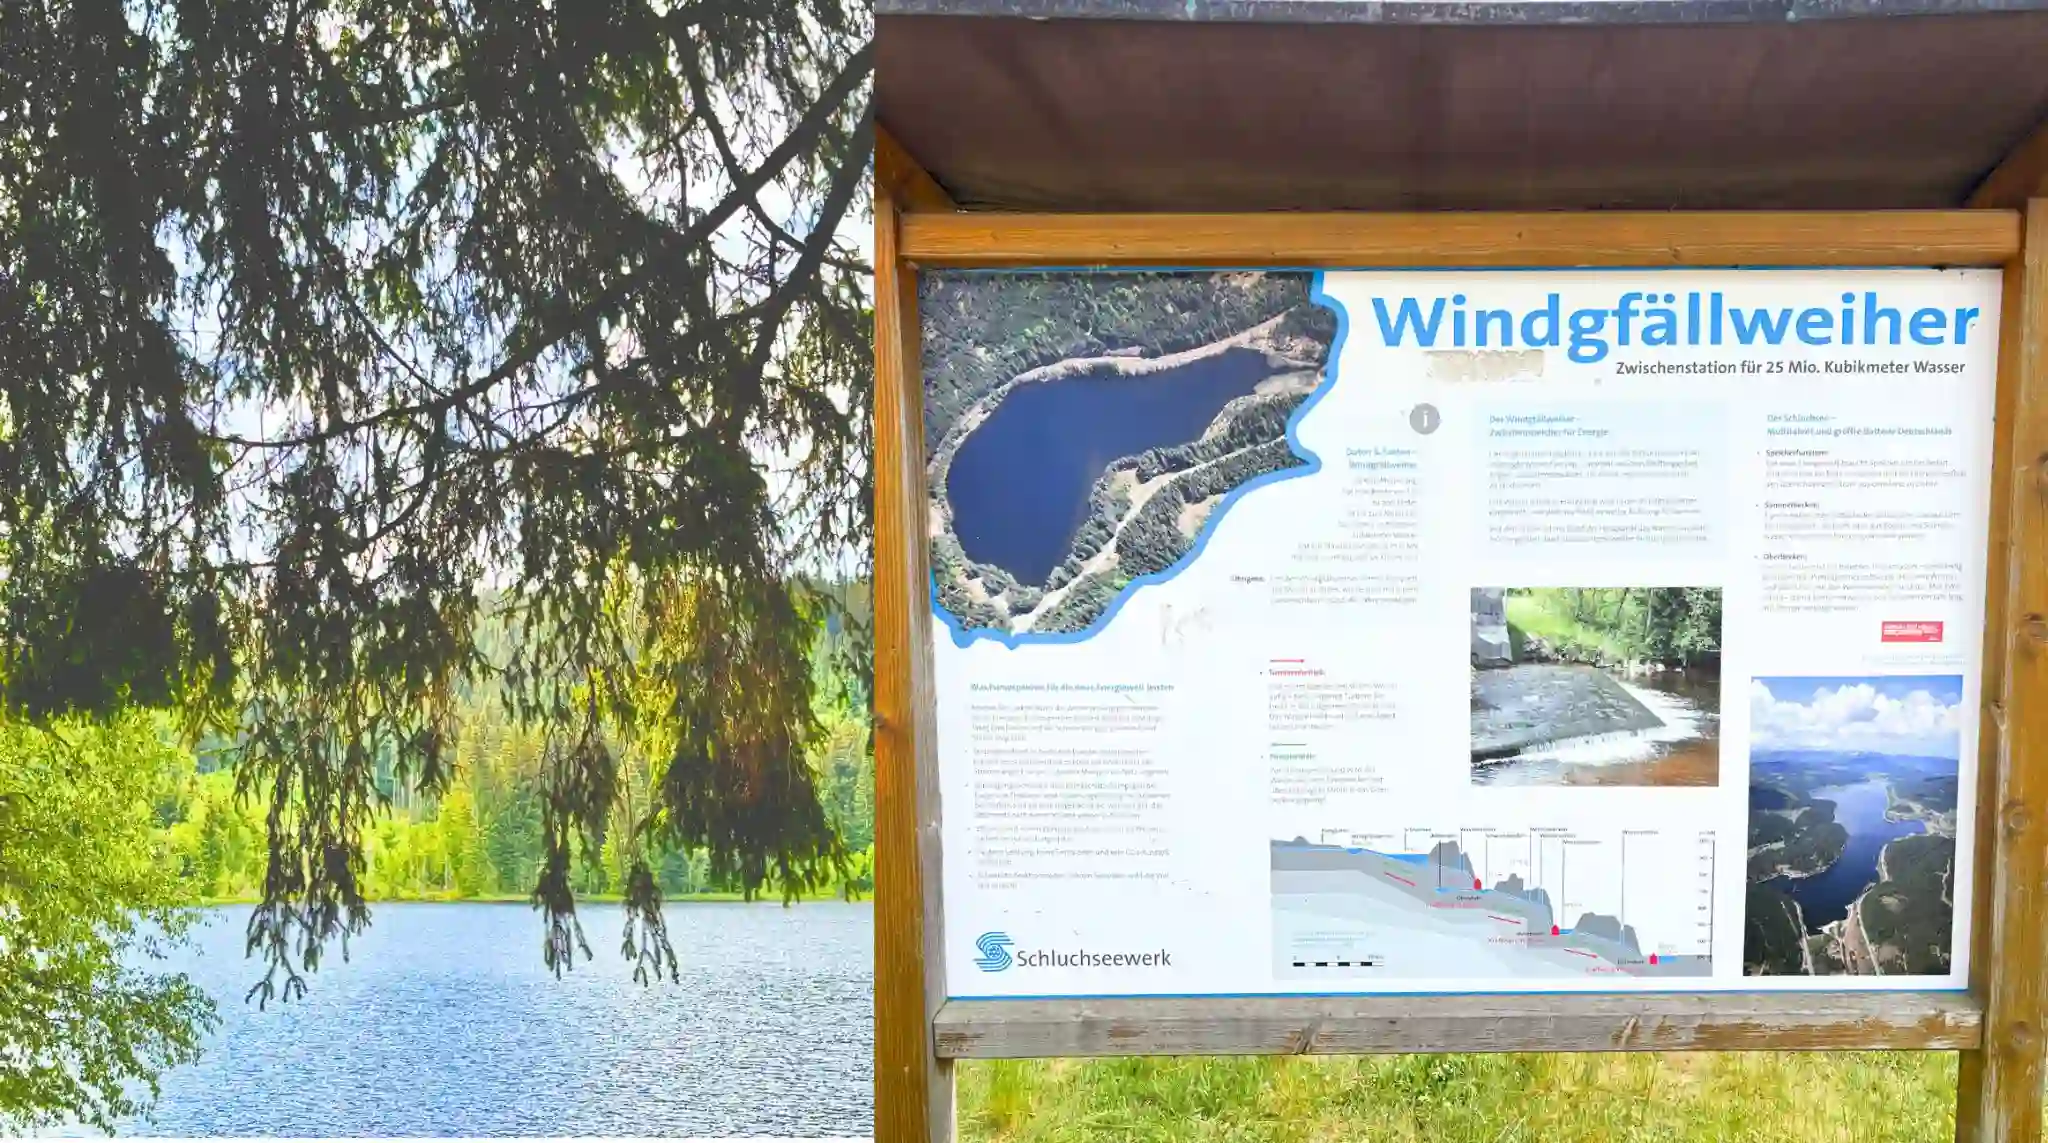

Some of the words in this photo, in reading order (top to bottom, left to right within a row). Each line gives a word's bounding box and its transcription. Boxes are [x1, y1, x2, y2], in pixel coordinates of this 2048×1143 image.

[1371, 291, 1980, 364] Windgfällweiher
[1616, 360, 1737, 375] Zwischenstation
[1740, 359, 1763, 375] für
[1766, 361, 1784, 375] 25
[1788, 360, 1821, 375] Mio.
[1824, 359, 1910, 375] Kubikmeter
[1913, 360, 1967, 375] Wasser
[1017, 948, 1172, 967] Schluchseewerk
